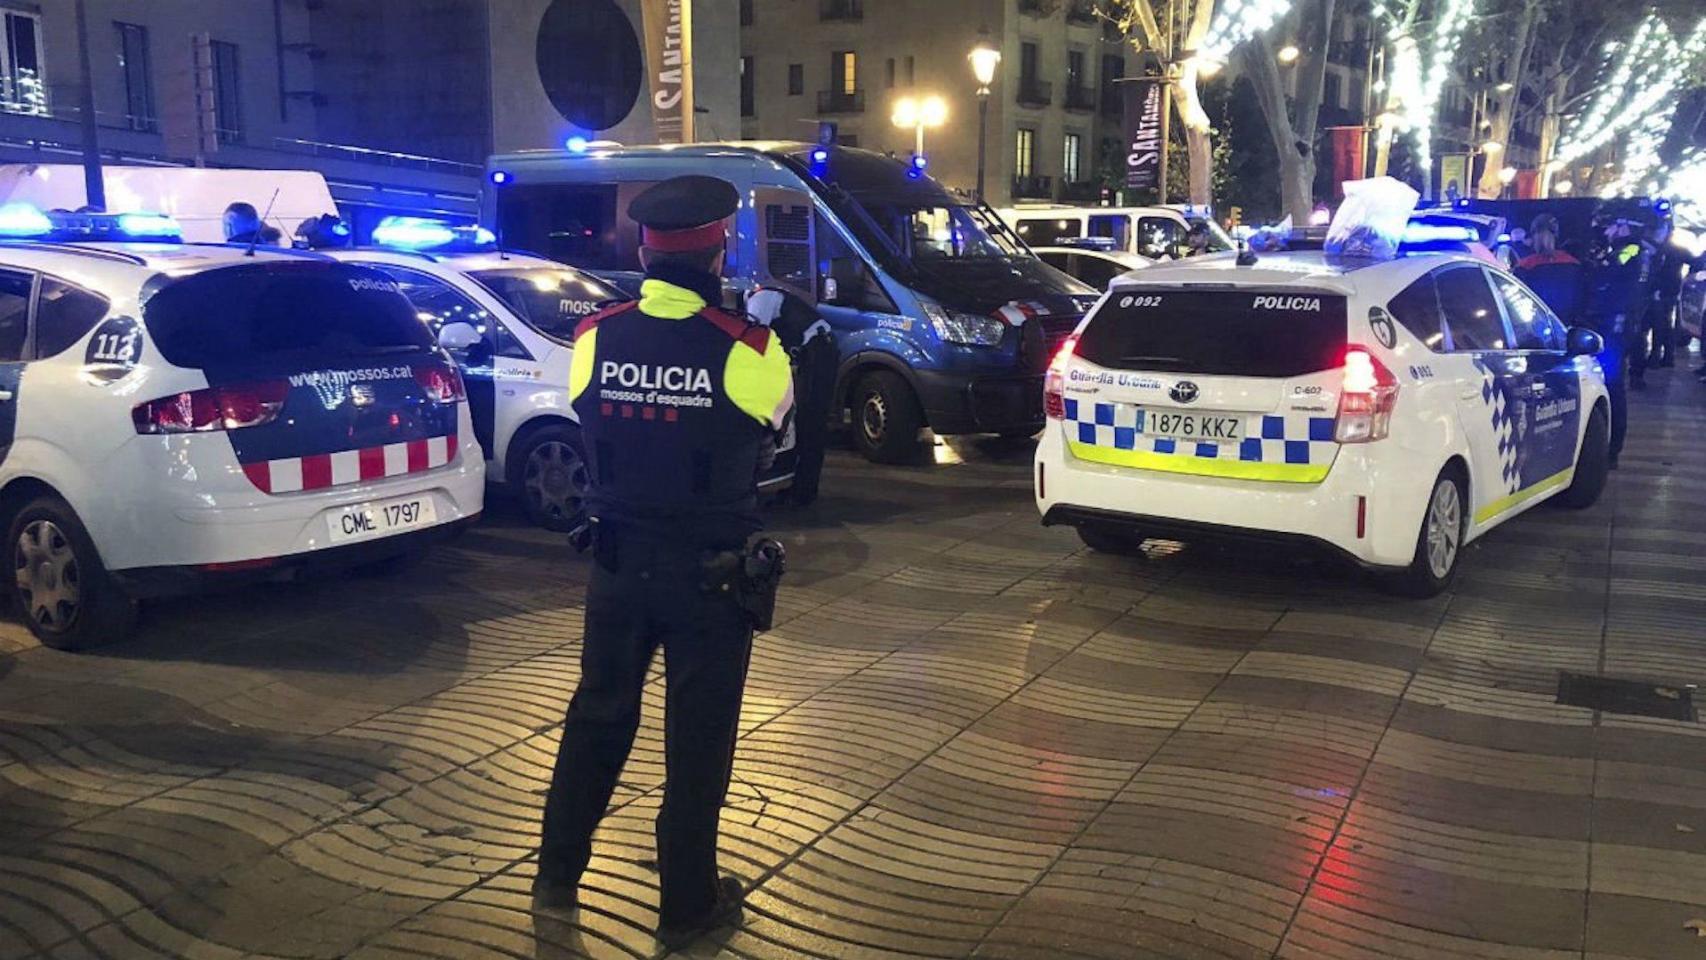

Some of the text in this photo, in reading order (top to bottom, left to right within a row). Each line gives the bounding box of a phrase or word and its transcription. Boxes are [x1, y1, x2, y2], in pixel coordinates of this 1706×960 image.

[1134, 296, 1162, 307] 092
[1252, 296, 1321, 311] POLICIA
[94, 333, 137, 360] 112
[288, 365, 413, 387] www.mossos.cat
[601, 361, 713, 392] POLICIA
[600, 389, 713, 407] mossos d'esquadra
[1151, 413, 1239, 438] 1876 KKZ
[341, 501, 420, 534] CME 1797
